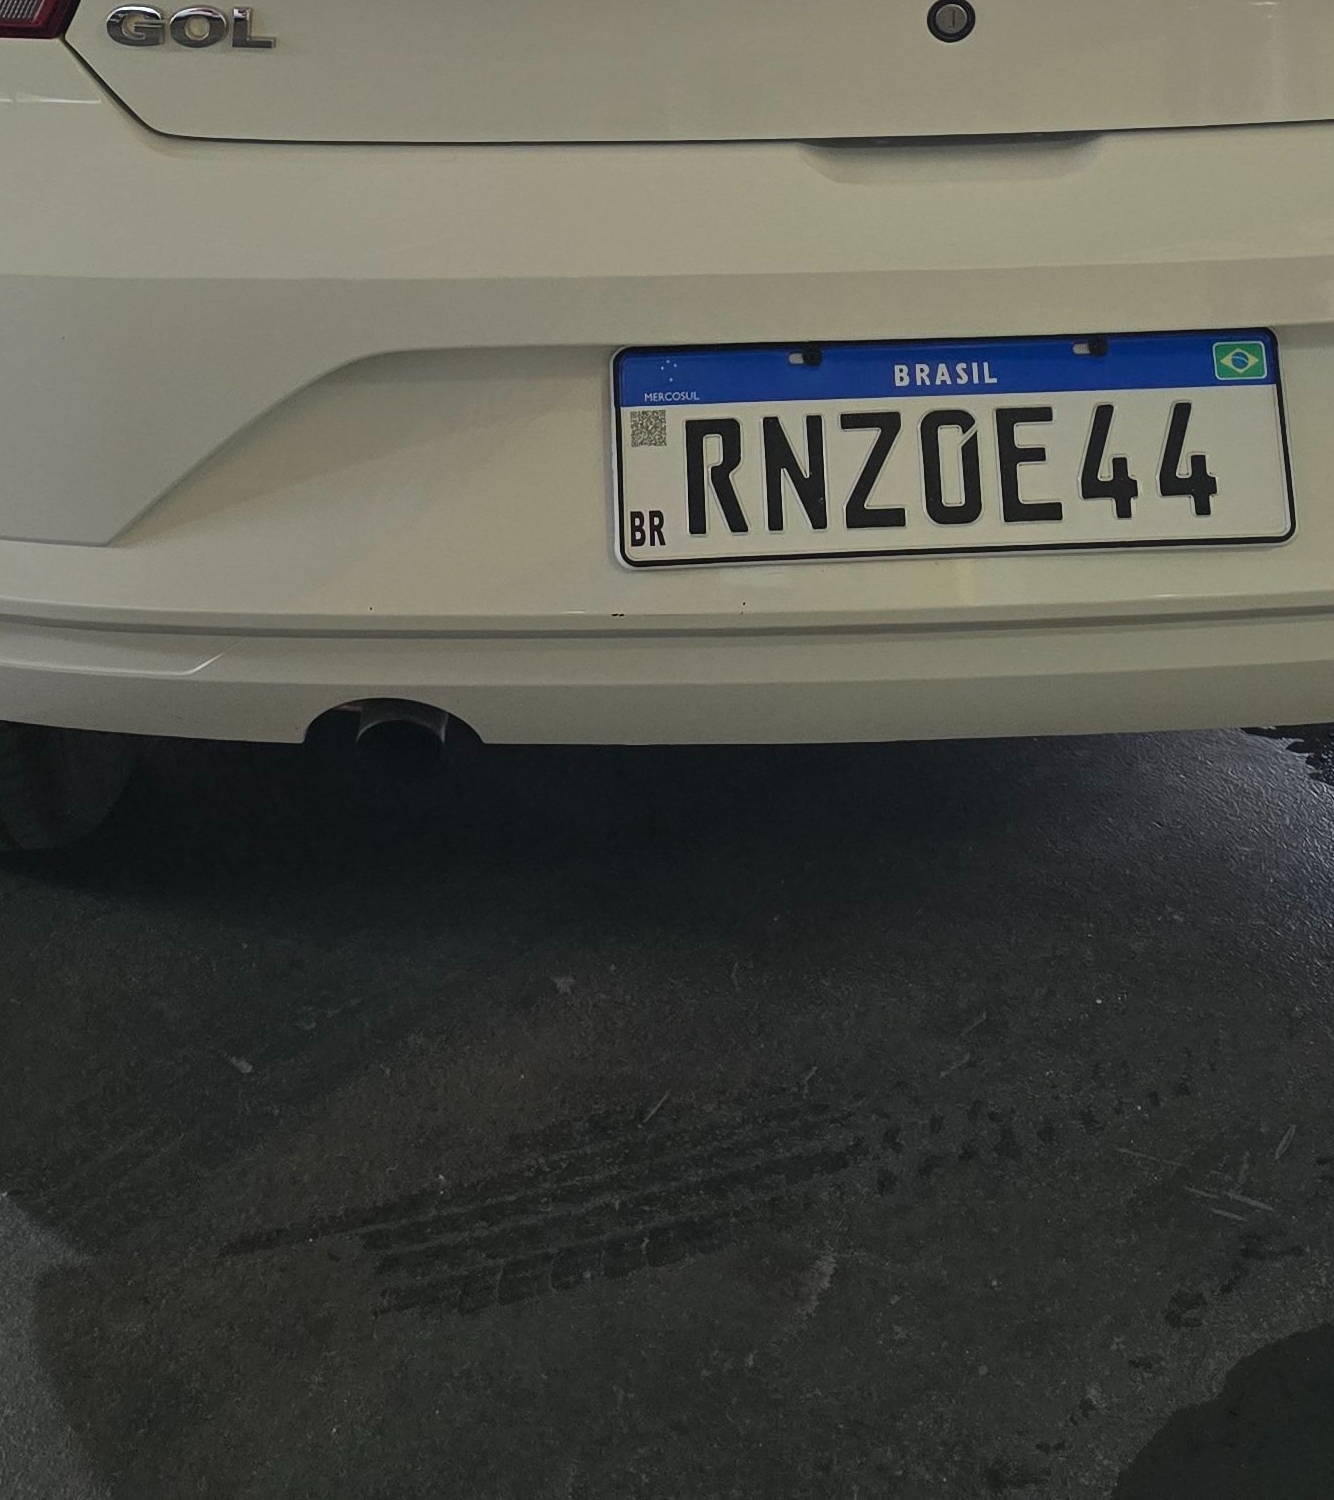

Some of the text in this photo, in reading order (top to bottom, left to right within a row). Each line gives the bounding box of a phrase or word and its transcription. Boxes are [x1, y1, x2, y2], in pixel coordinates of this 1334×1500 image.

[106, 4, 276, 49] GOL
[893, 361, 998, 387] BRASIL
[644, 391, 700, 402] MERCOSUL
[630, 510, 666, 547] BR
